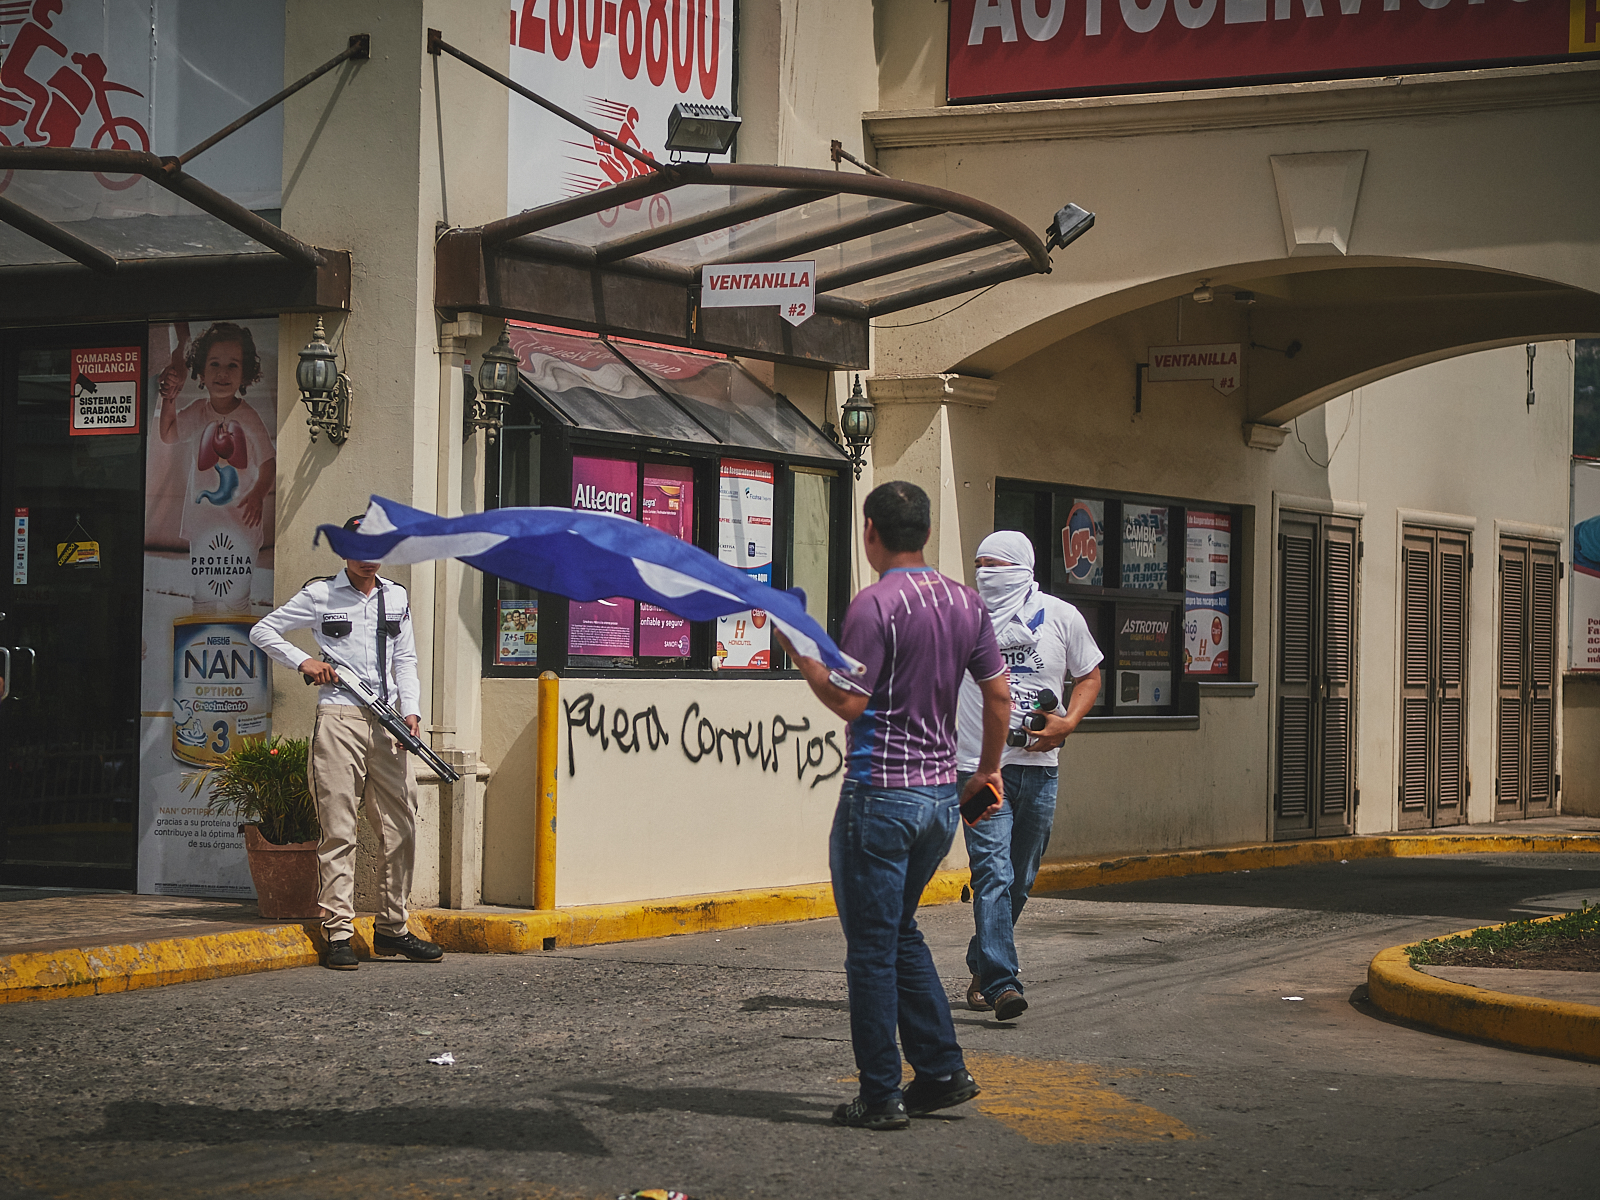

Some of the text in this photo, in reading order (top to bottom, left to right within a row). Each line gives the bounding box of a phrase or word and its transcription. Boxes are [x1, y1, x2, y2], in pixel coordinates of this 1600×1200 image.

[709, 272, 809, 290] VENTANILLA
[788, 303, 806, 316] #2
[76, 352, 138, 363] CAMARAS DE
[1155, 352, 1237, 367] VENTANILLA
[78, 363, 135, 374] VIGILANCIA
[1220, 377, 1234, 388] #1
[79, 396, 132, 405] SISTEMA DE
[80, 405, 131, 415] GRABACION
[84, 415, 127, 424] 24 HORAS
[574, 484, 631, 515] Allegra
[1126, 525, 1156, 543] CAMBIA
[191, 554, 252, 565] PROTEÍNA
[191, 566, 252, 575] OPTIMIZADA
[1121, 618, 1169, 634] ASTROTON
[207, 636, 230, 645] Nestlé
[184, 649, 255, 679] NAN
[195, 686, 243, 697] OPTIPRO
[193, 700, 248, 712] Crecimiento
[211, 720, 230, 754] 3
[156, 818, 182, 827] gracias
[201, 818, 231, 828] proteína
[154, 829, 193, 838] contribuye
[209, 830, 235, 839] óptima
[188, 840, 197, 848] de
